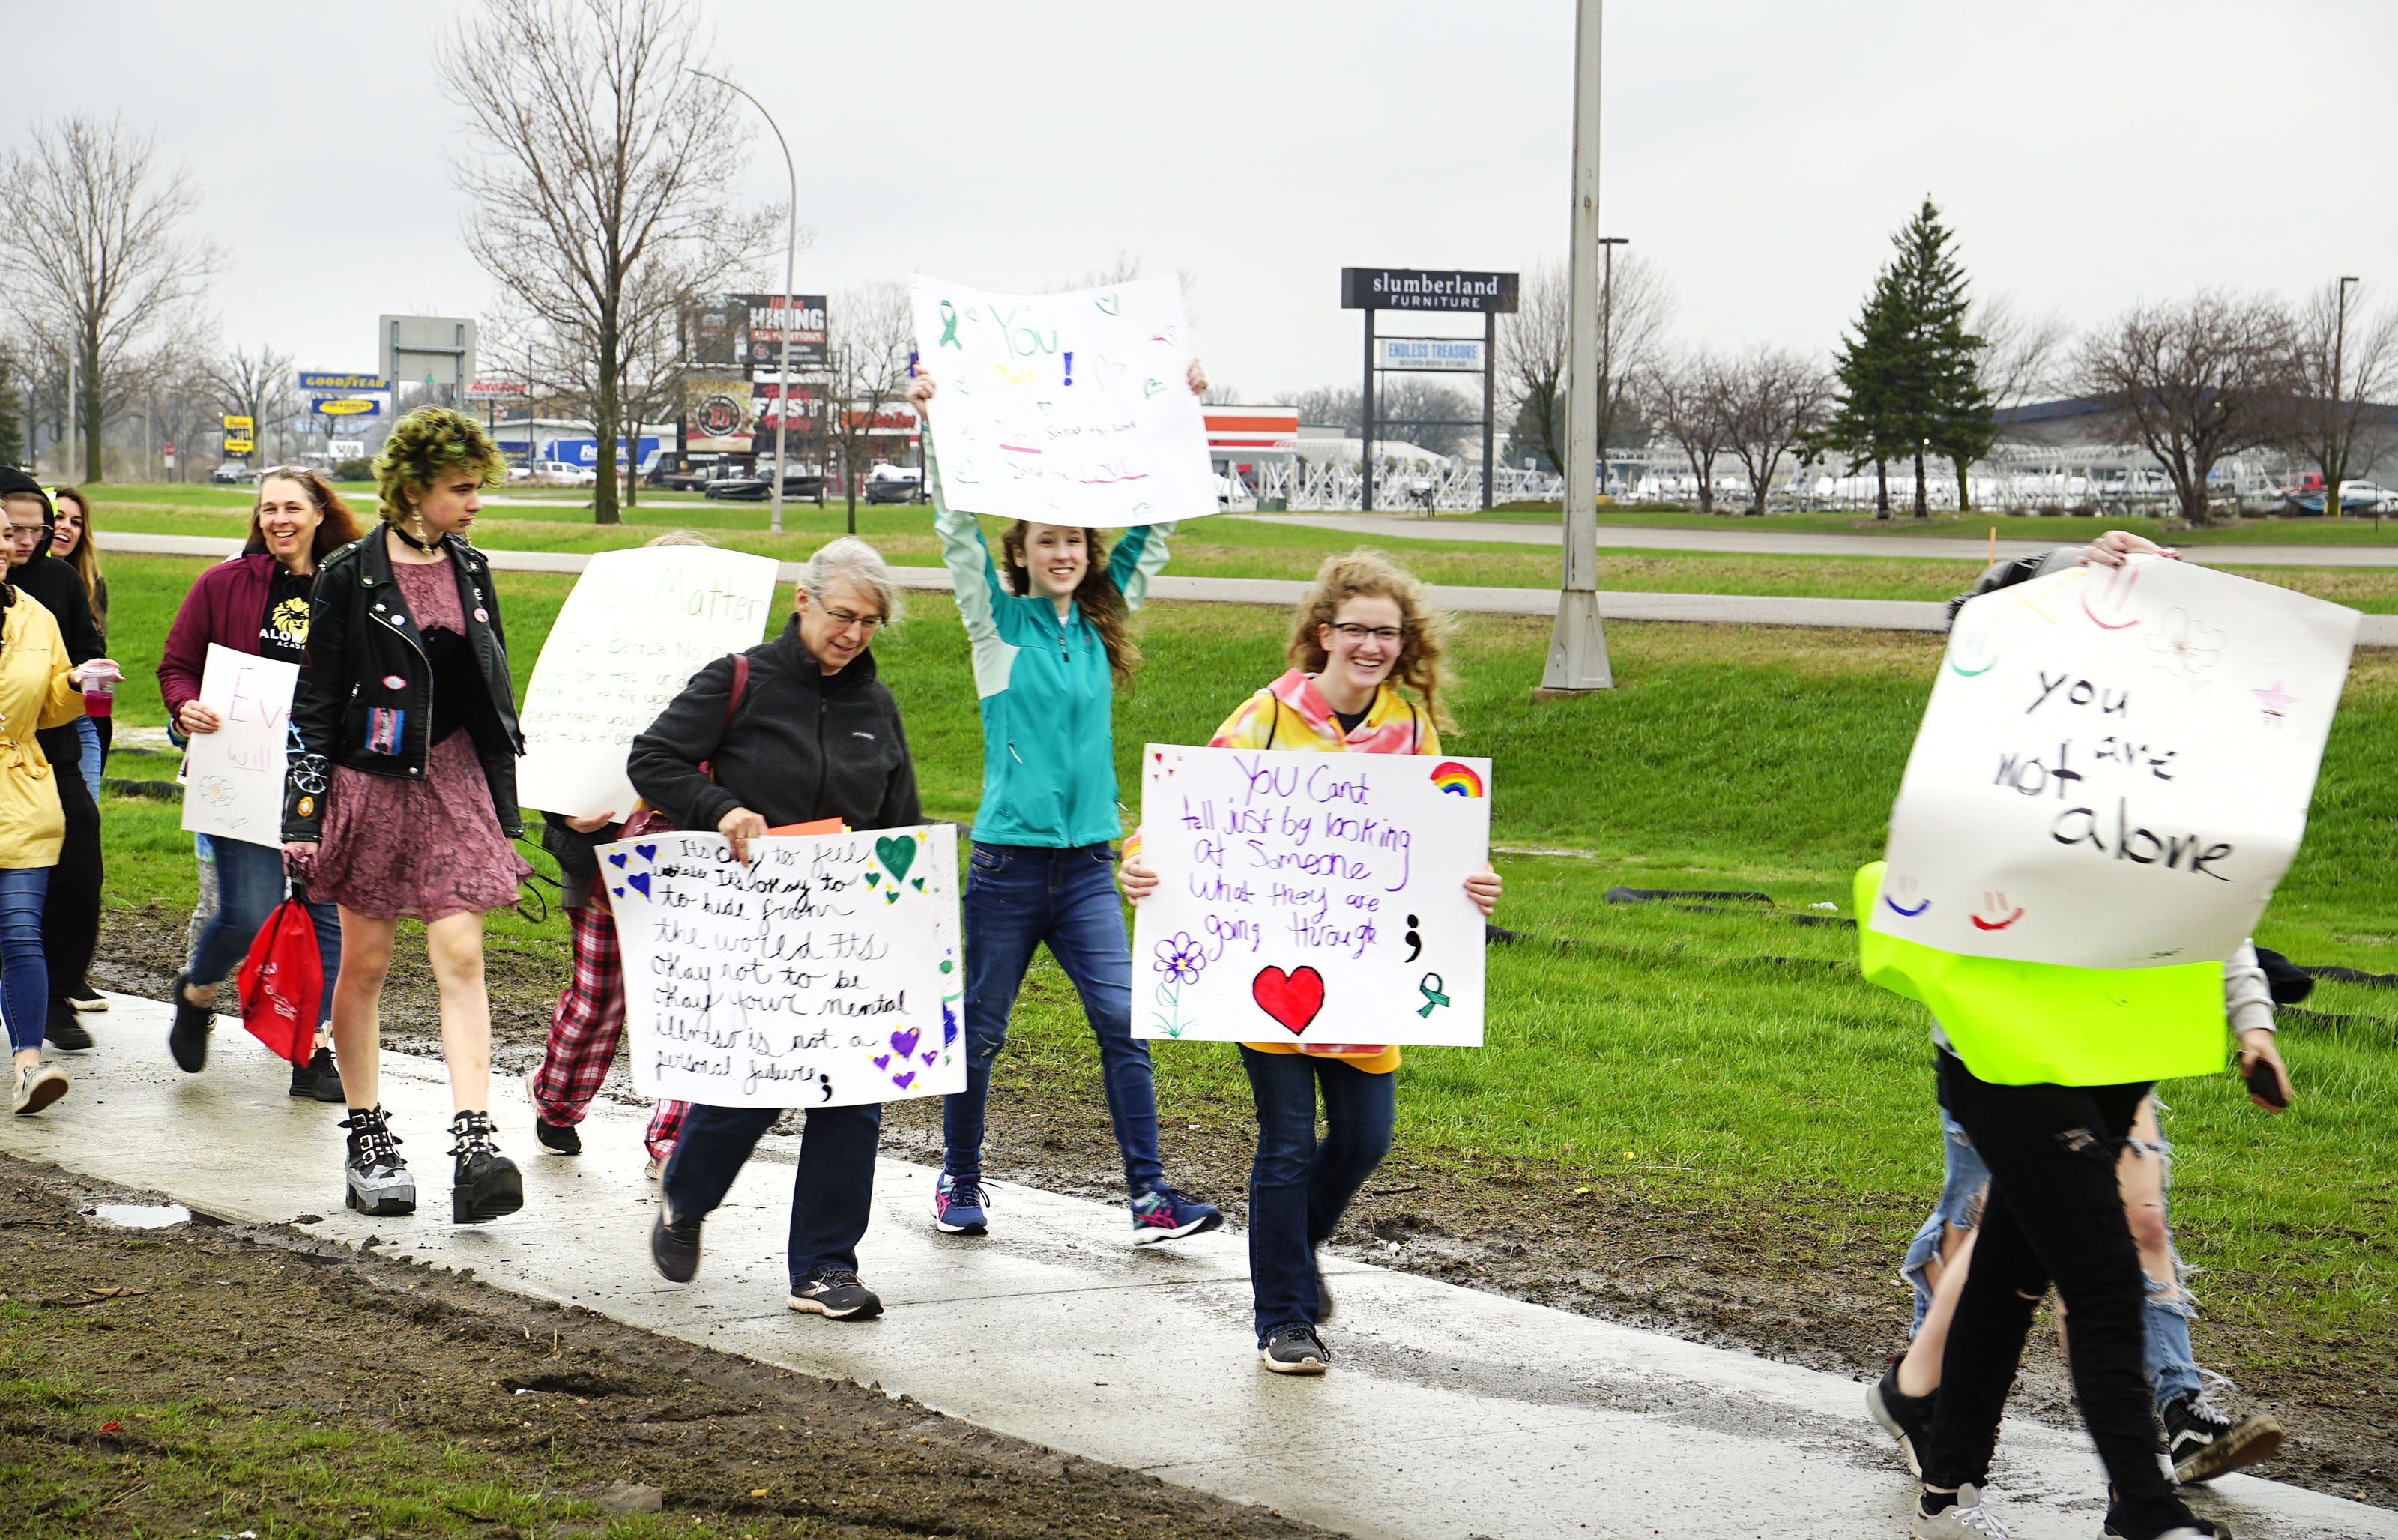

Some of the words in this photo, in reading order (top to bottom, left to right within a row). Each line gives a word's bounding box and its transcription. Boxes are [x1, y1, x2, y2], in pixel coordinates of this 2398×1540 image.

[1372, 272, 1499, 295] slumberland
[749, 307, 824, 330] HIRING
[1391, 295, 1481, 309] FURNITURE
[986, 303, 1058, 359] You
[1389, 342, 1428, 358] ENDLESS
[1432, 343, 1478, 360] TREASURE
[306, 375, 386, 389] GOODYEAR
[752, 397, 824, 417] FAST
[650, 567, 766, 622] Matter
[677, 641, 701, 661] No
[2025, 671, 2131, 718] you
[606, 714, 635, 732] you
[2094, 735, 2178, 781] are
[1180, 792, 1215, 830] tell
[1224, 797, 1273, 835] just
[1281, 806, 1313, 846] by
[1325, 812, 1411, 892] looking
[2049, 796, 2235, 883] alone
[771, 845, 801, 866] to
[813, 841, 872, 879] feel
[659, 884, 699, 908] to
[701, 892, 751, 921] hide
[758, 898, 857, 937] from
[1267, 882, 1329, 924] they
[1346, 893, 1380, 913] are
[650, 917, 707, 949] the
[1204, 908, 1261, 962] going
[1286, 911, 1379, 960] through
[719, 957, 773, 985] not
[779, 966, 830, 989] to
[832, 970, 869, 991] be
[729, 991, 810, 1033] your
[815, 989, 912, 1018] mental
[788, 1027, 840, 1053] not
[848, 1035, 880, 1047] a
